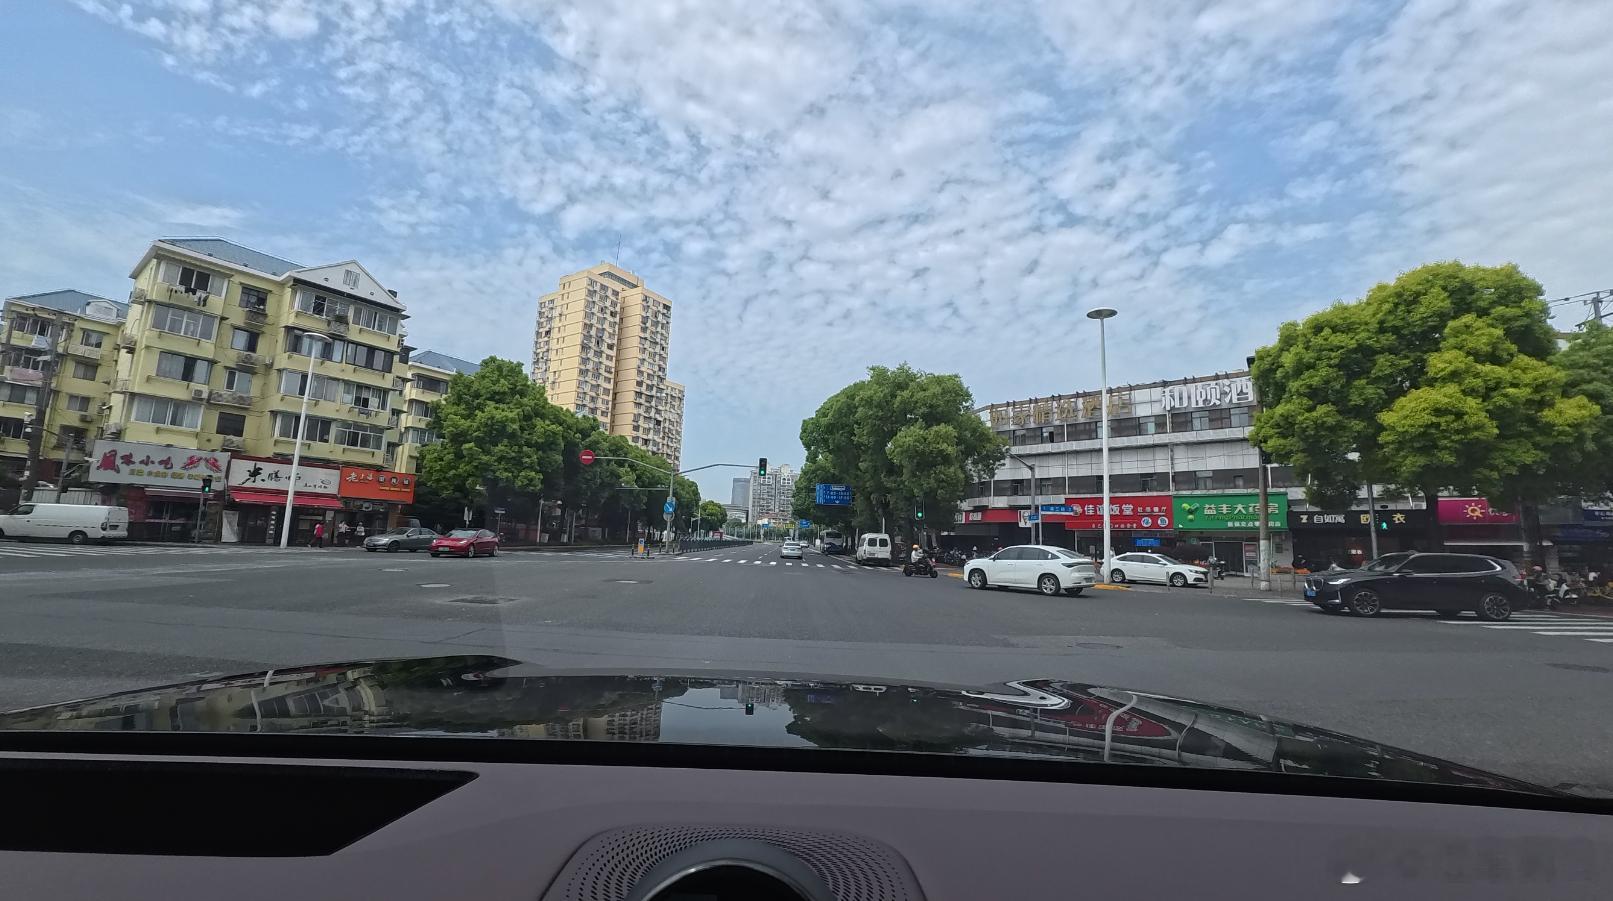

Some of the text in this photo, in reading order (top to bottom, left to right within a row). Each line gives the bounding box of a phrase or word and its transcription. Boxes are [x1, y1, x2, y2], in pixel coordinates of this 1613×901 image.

[1161, 379, 1254, 410] 和颐酒
[1203, 503, 1280, 515] 益丰大药房
